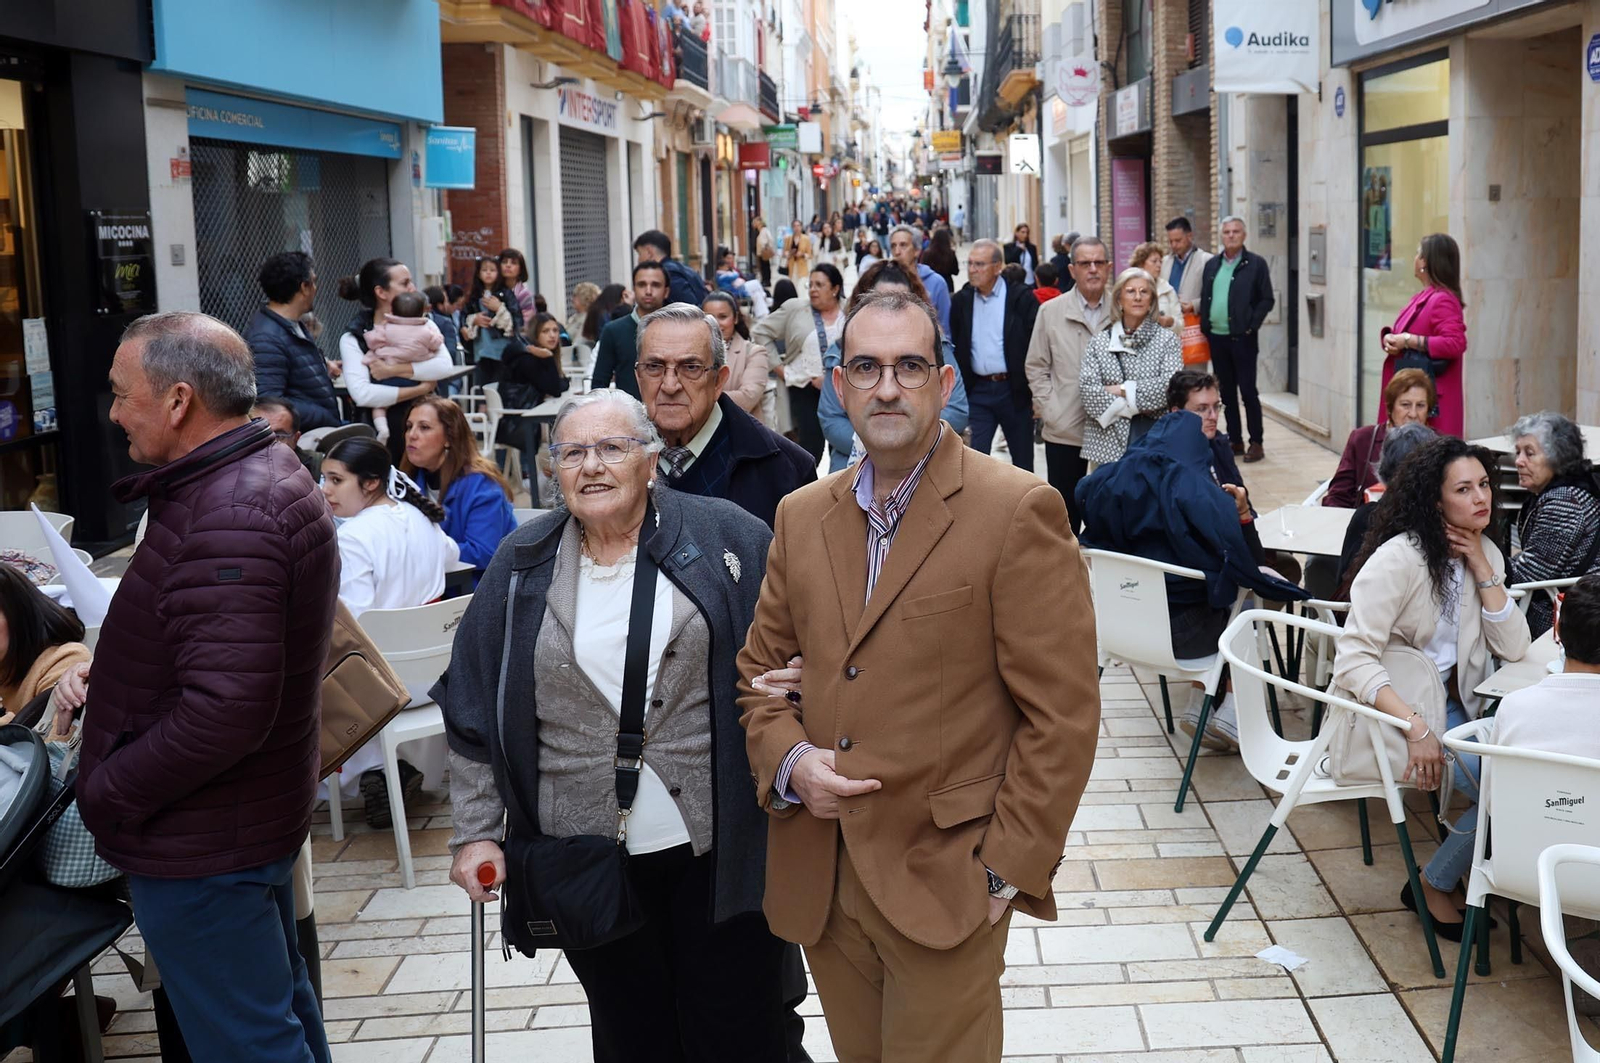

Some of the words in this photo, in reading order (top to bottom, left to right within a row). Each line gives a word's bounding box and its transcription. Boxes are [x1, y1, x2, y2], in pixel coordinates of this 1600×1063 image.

[1247, 32, 1309, 46] Audika
[566, 88, 617, 129] INTERSPORT
[220, 109, 264, 128] COMERCIAL
[427, 135, 459, 145] Sanitas
[98, 225, 150, 239] MICOCINA
[1545, 796, 1585, 808] SanMiguel
